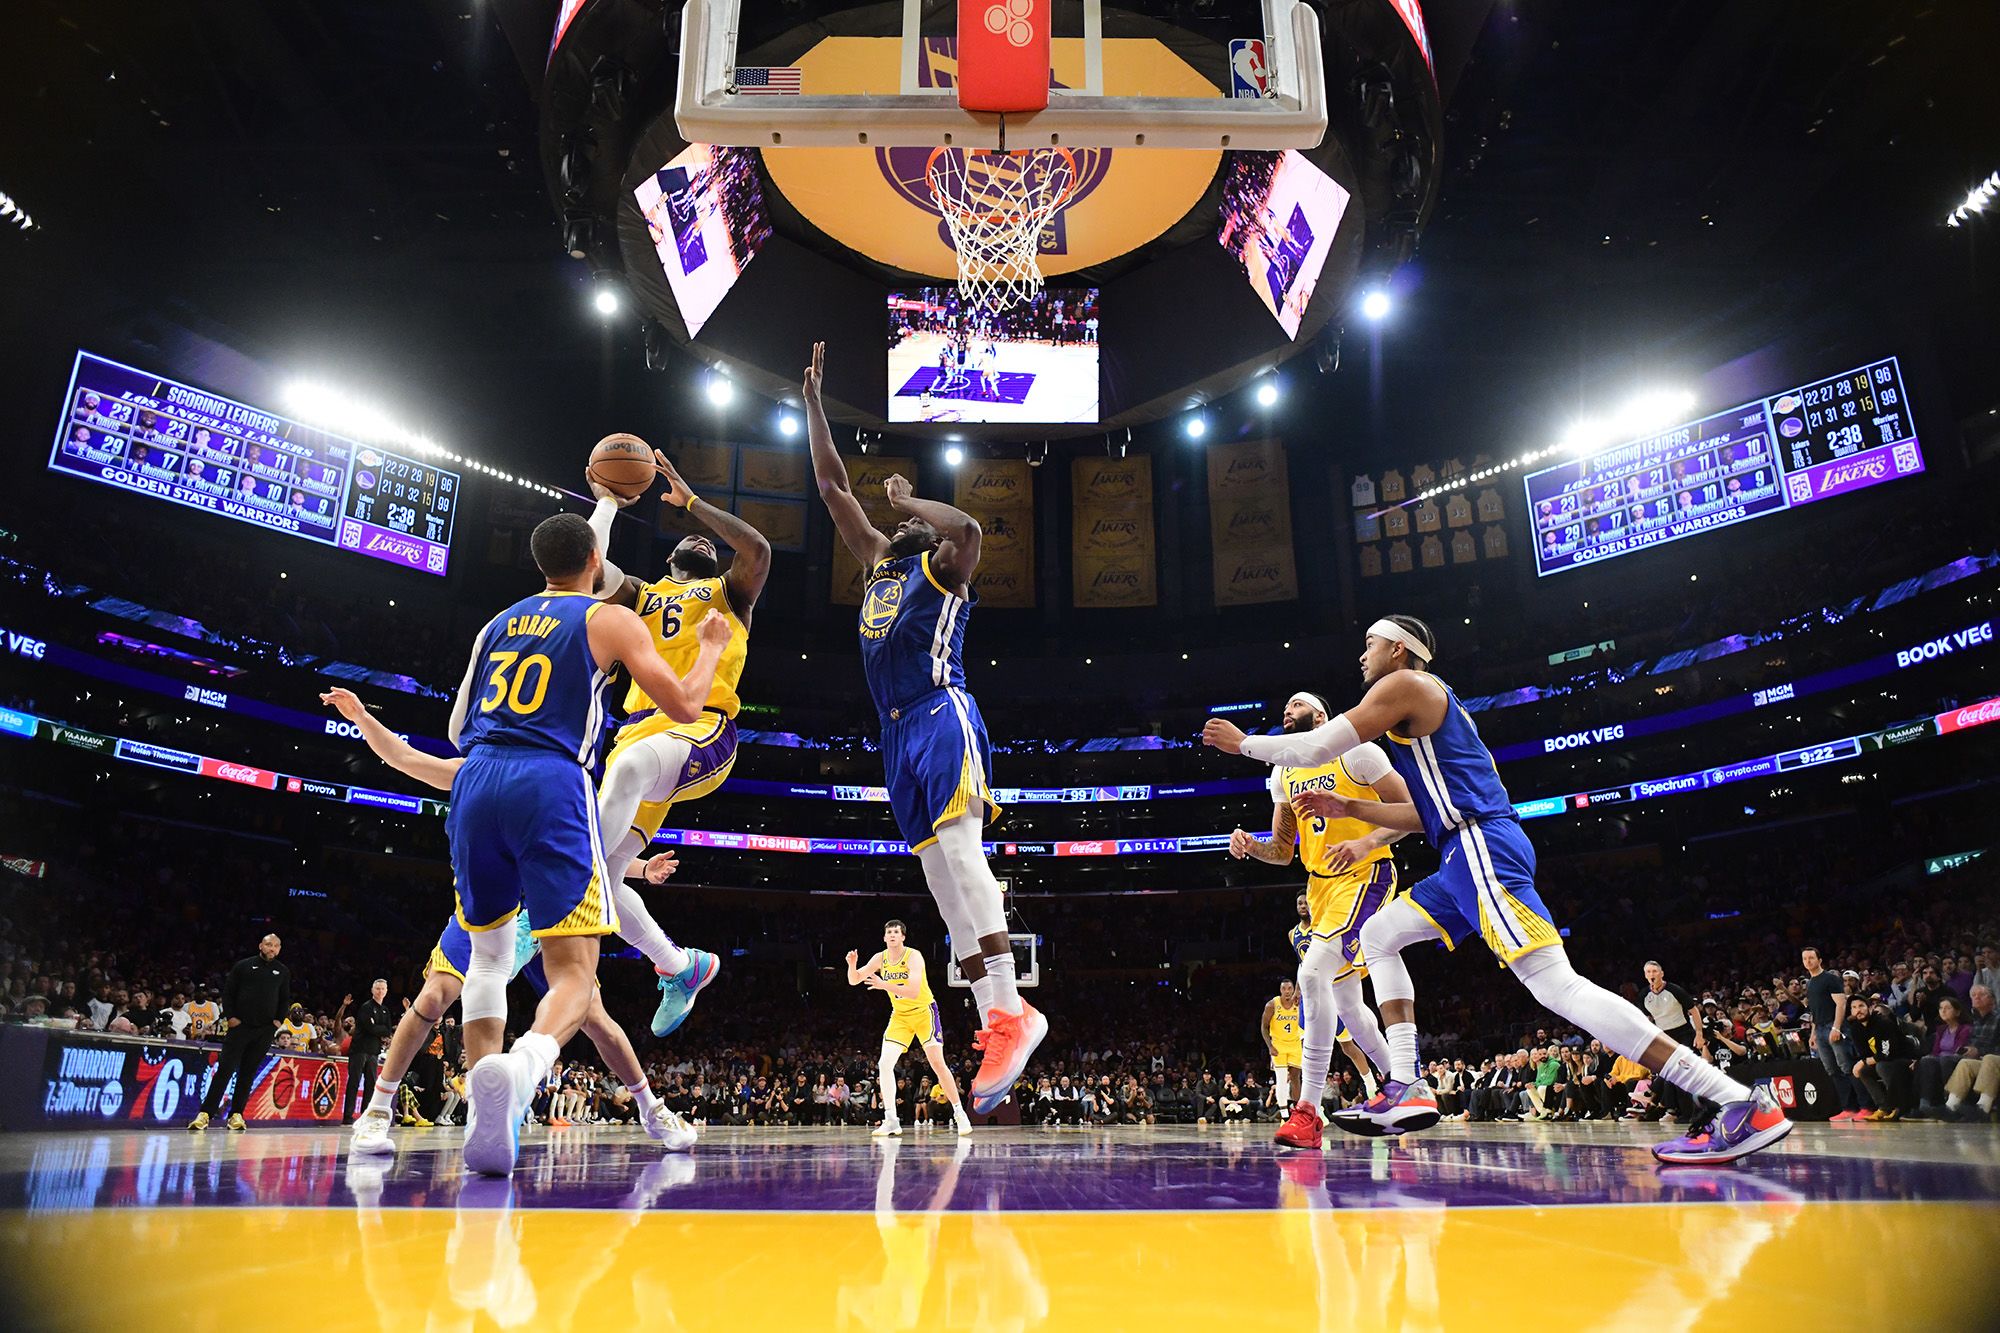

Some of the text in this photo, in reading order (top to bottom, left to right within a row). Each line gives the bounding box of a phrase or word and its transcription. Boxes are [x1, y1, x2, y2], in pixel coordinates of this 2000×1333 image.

[1238, 89, 1256, 99] NBA
[1805, 366, 1892, 407] 22 27 28 19 96
[109, 402, 133, 422] 23
[167, 387, 280, 435] SCORING LEADERS
[1810, 388, 1897, 428] 21 31 32 15 99
[121, 391, 315, 458] LOS ANGELES LAKERS
[1743, 413, 1762, 426] GAME
[1872, 412, 1899, 426] Warriors
[166, 421, 188, 440] 23
[1826, 423, 1863, 450] 2:38
[101, 436, 124, 455] 29
[220, 437, 240, 456] 21
[1593, 429, 1690, 472] SCORING LEADERS
[1746, 439, 1760, 456] 10
[1791, 439, 1810, 451] Lakers
[162, 453, 179, 470] 17
[275, 453, 288, 470] 11
[1563, 434, 1731, 493] LOS ANGELES LAKERS
[1698, 454, 1710, 471] 11
[216, 468, 232, 487] 15
[322, 468, 337, 485] 10
[385, 460, 452, 493] 22 27 28 19 96
[973, 474, 1017, 489] LAKERS
[1090, 471, 1135, 487] LAKERS
[1650, 468, 1664, 485] 21
[1755, 470, 1765, 487] 9
[1818, 459, 1891, 494] LAKERS
[267, 484, 282, 501] 10
[1356, 481, 1369, 492] 99
[1603, 482, 1619, 500] 23
[1703, 484, 1717, 501] 10
[101, 467, 300, 530] GOLDEN STATE WARRIORS
[382, 479, 449, 512] 21 31 32 15 99
[1560, 495, 1575, 512] 23
[318, 499, 329, 514] 9
[387, 503, 416, 526] 2:38
[1656, 498, 1669, 515] 15
[1091, 519, 1137, 535] LAKERS
[1610, 511, 1623, 528] 17
[1565, 525, 1579, 542] 29
[1573, 506, 1747, 562] GOLDEN STATE WARRIORS
[364, 533, 423, 564] LAKERS
[976, 571, 1016, 588] LAKERS
[1093, 570, 1139, 587] LAKERS
[882, 585, 899, 601] 23
[507, 615, 561, 639] CURRY
[661, 603, 683, 640] 6
[9, 630, 46, 658] VEG
[1896, 622, 1993, 668] BOOK VEG
[480, 651, 552, 715] 30
[1766, 683, 1793, 698] MGM
[200, 688, 228, 703] MGM
[200, 698, 227, 709] REWARDS
[1768, 692, 1795, 703] REWARDS
[1211, 704, 1238, 713] AMERICAN
[1544, 724, 1625, 752] BOOK VEG
[130, 745, 152, 757] Nolan
[152, 749, 189, 764] Thompson
[1800, 746, 1835, 764] 9:22
[217, 763, 258, 785] Coca-Cola
[1725, 761, 1771, 778] crypto.com
[303, 783, 336, 796] TOYOTA
[1289, 773, 1336, 803] LAKERS
[1640, 776, 1696, 797] Spectrum
[353, 792, 416, 809] AMERICAN EXPRESS
[1024, 792, 1057, 800] Warriors
[1071, 791, 1087, 800] 99
[1589, 791, 1621, 803] TOYOTA
[750, 837, 806, 850] TOSHIBA
[1069, 842, 1103, 854] Coca-Cola
[1135, 841, 1175, 851] DELTA
[1203, 837, 1230, 845] Thompson
[883, 970, 909, 981] LAKERS
[195, 1019, 203, 1030] 8
[1284, 1023, 1291, 1033] 4
[60, 1048, 126, 1079] TOMORROW
[185, 1074, 197, 1096] VS
[87, 1087, 101, 1111] ET
